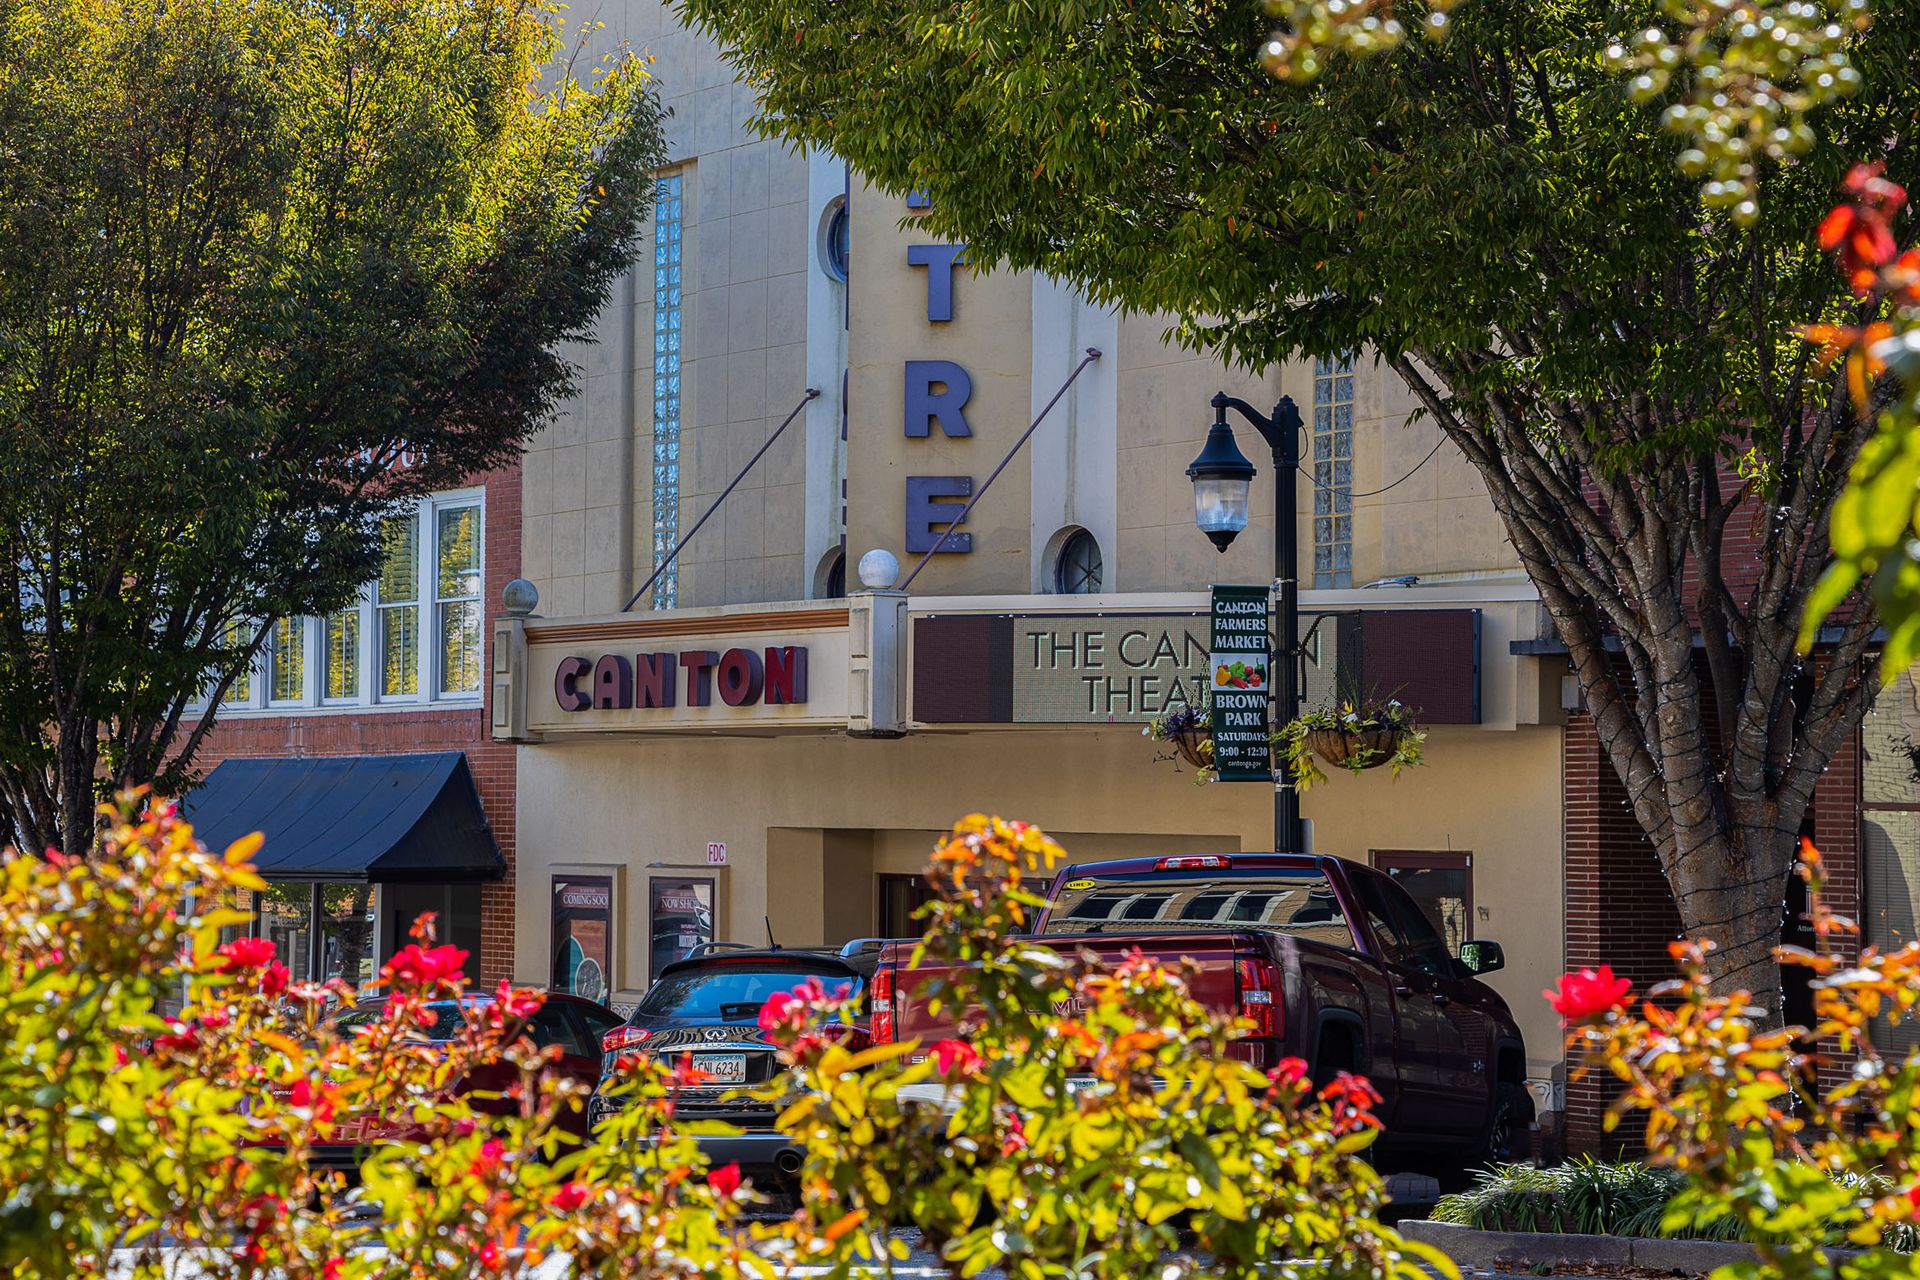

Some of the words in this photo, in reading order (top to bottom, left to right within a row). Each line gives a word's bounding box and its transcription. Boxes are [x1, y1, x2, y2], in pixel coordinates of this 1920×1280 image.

[905, 187, 972, 553] TRE
[1216, 601, 1266, 614] CANTON
[1215, 618, 1267, 630] FARMERS
[1215, 635, 1267, 649] MARKET
[1026, 631, 1105, 670] THE
[1118, 629, 1321, 670] CANN
[555, 646, 809, 712] CANTON
[1082, 675, 1212, 715] THEAT
[1216, 694, 1267, 709] BROWN
[1225, 712, 1262, 726] PARK
[1219, 746, 1239, 757] 9:00
[1247, 746, 1268, 757] 12:30
[1227, 761, 1262, 769] cantonga.gov
[708, 844, 725, 862] FDC
[562, 894, 592, 905] COMING
[661, 898, 679, 909] NOW
[1025, 997, 1089, 1015] MC
[715, 1061, 740, 1076] 6234
